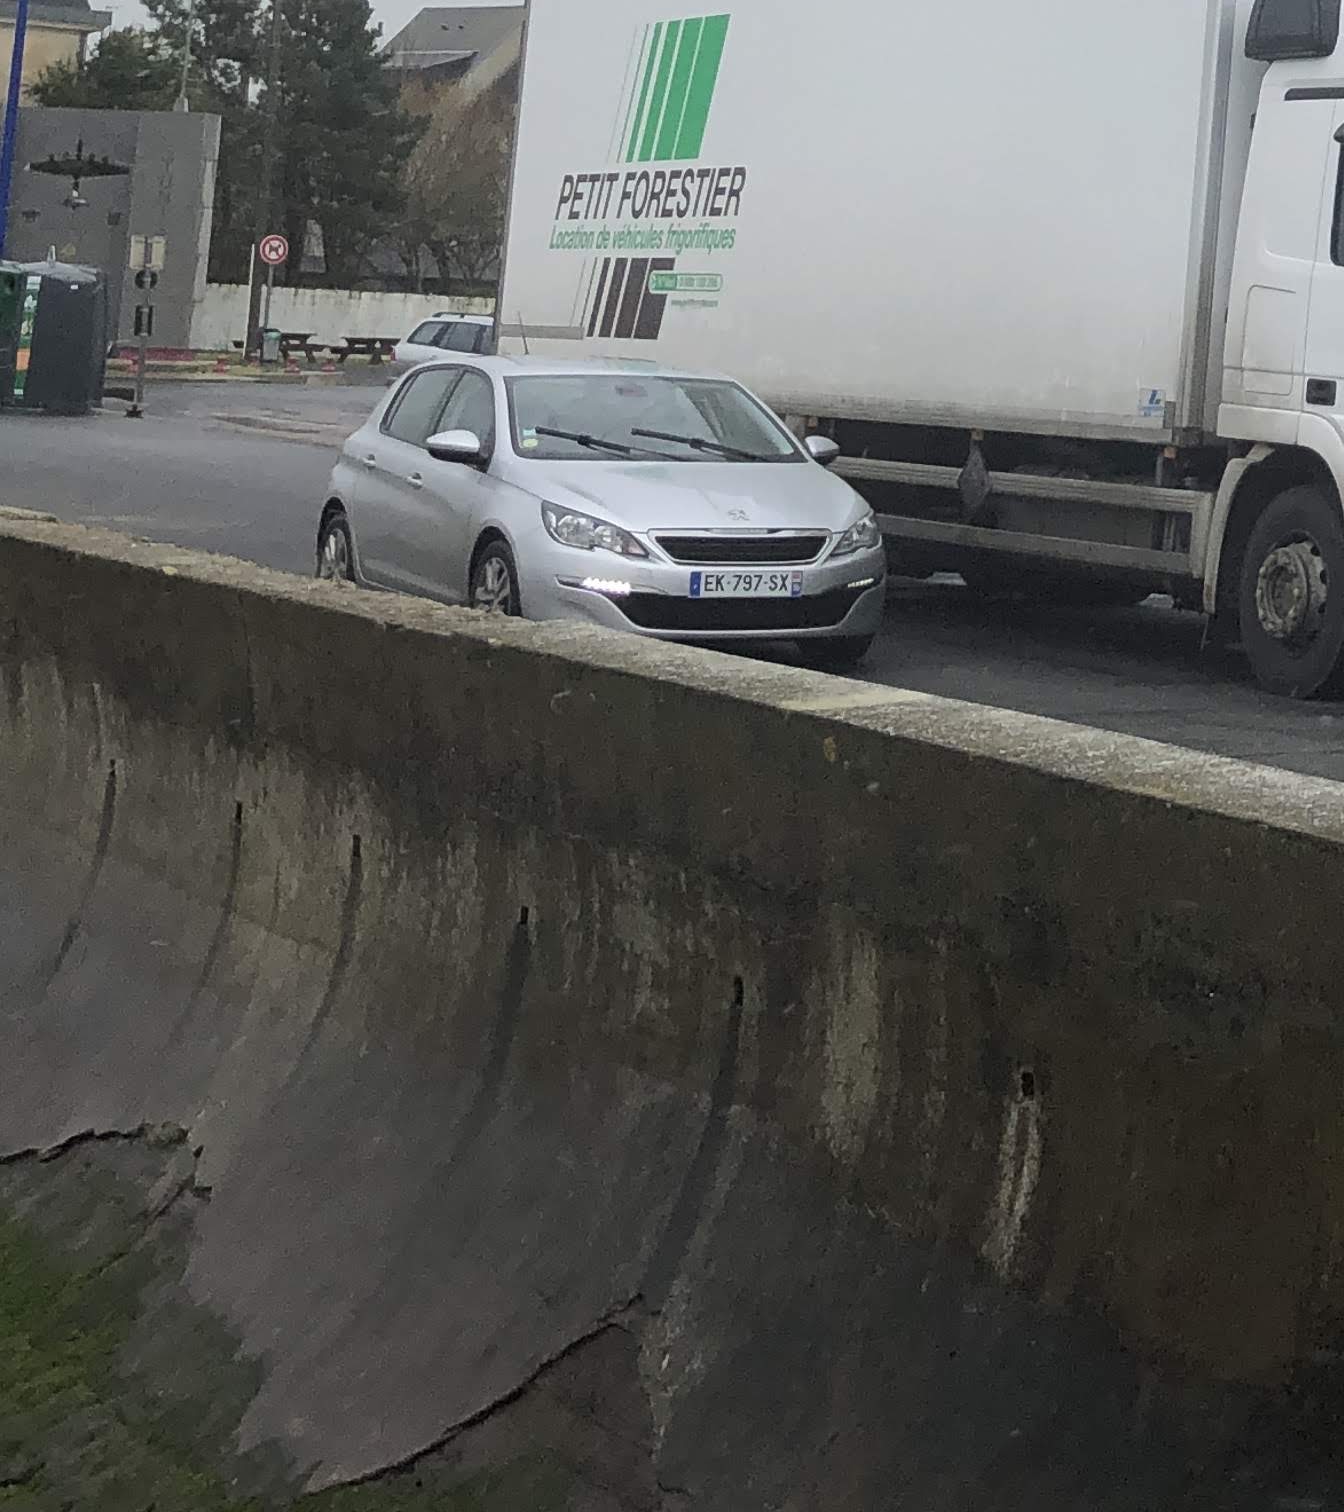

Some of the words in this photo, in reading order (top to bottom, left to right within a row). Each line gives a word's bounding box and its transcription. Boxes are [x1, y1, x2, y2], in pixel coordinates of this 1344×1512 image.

[555, 172, 619, 220] PETIT
[616, 167, 747, 219] FORESTIER
[549, 223, 594, 250] Location
[595, 223, 611, 250] de
[612, 222, 664, 250] véhicules
[665, 221, 737, 255] frigorifiques
[704, 573, 789, 592] EK-797-SX
